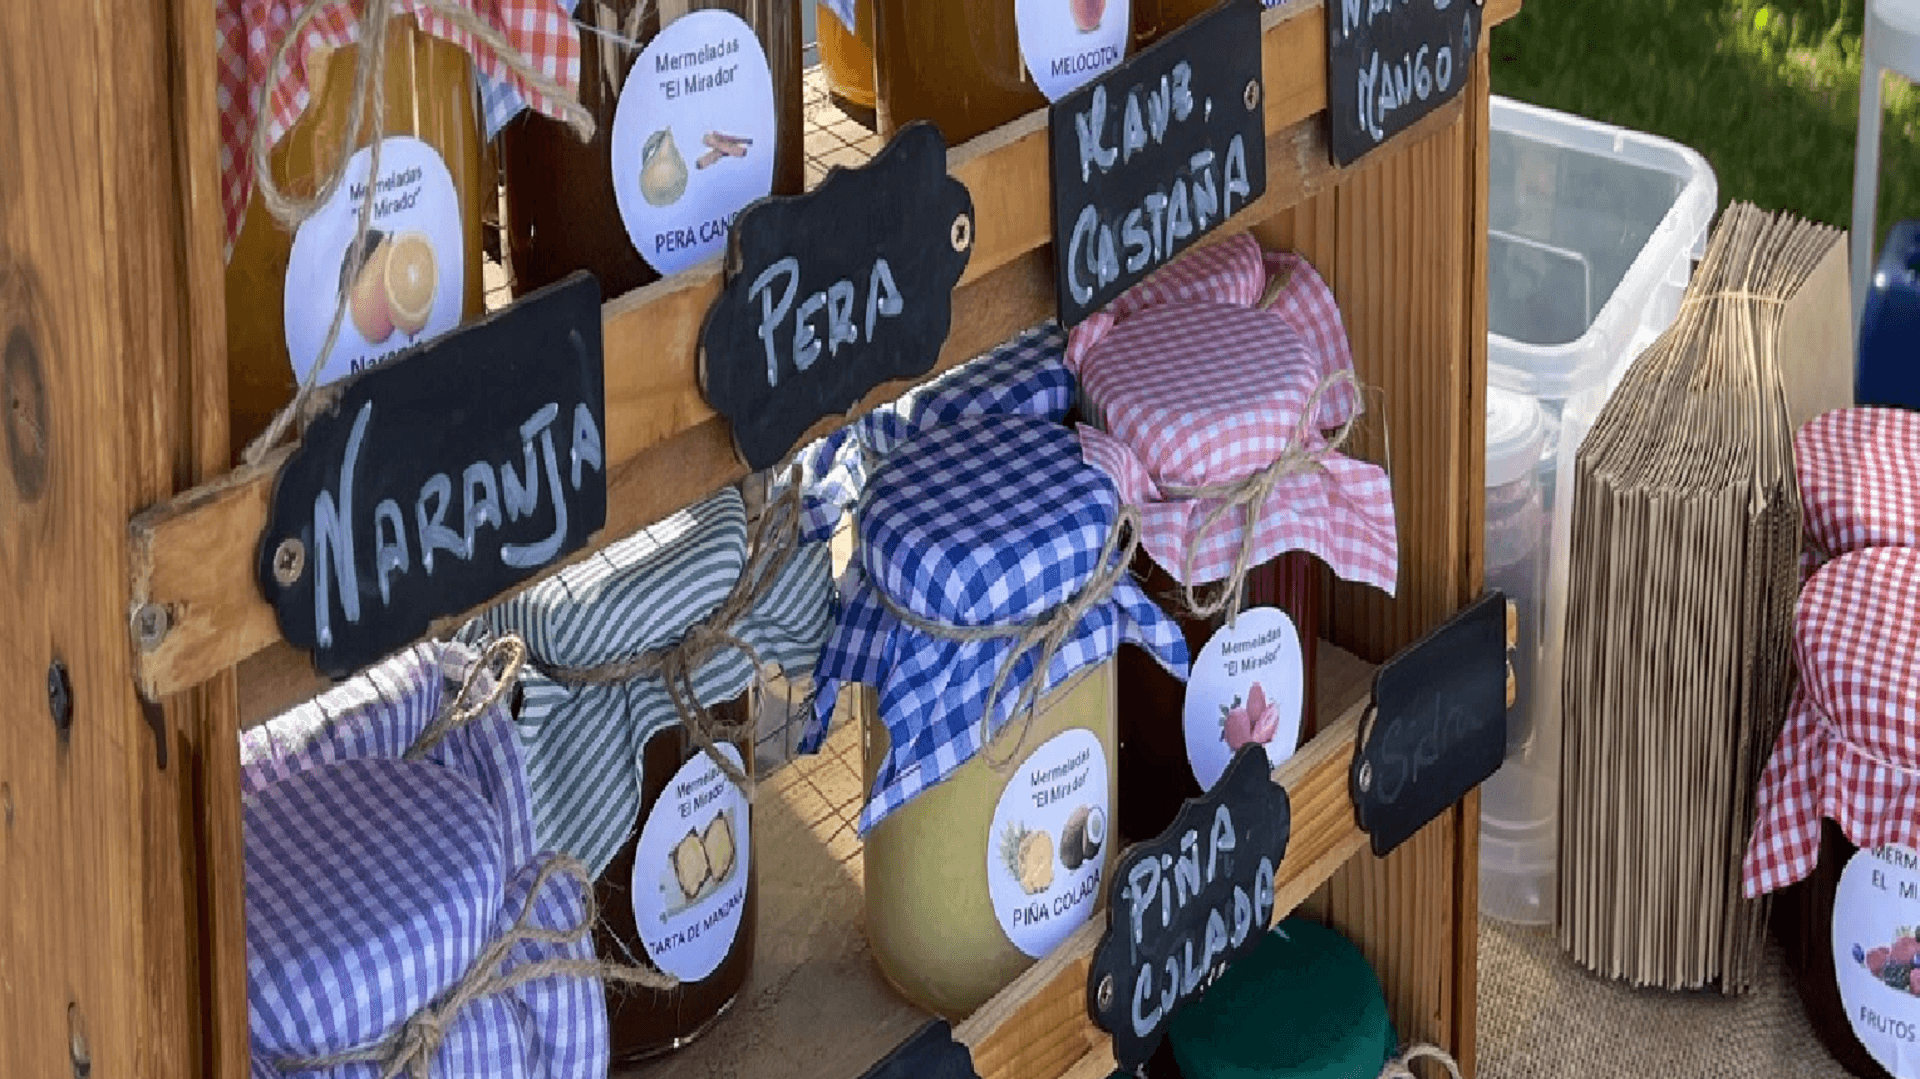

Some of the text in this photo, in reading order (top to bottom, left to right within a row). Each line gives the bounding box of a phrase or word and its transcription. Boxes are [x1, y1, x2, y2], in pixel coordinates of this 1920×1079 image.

[655, 38, 740, 74] Mermeladas
[1357, 43, 1452, 142] MANGO
[350, 165, 423, 201] Memeladas
[1067, 133, 1250, 306] CASTAÑA
[655, 226, 697, 254] PERA
[748, 255, 904, 388] PERA
[313, 399, 602, 649] NARANJA
[1030, 747, 1090, 788] Mermeladas
[1012, 867, 1101, 930] PIÑA COLADA
[1871, 868, 1888, 893] EL
[649, 930, 686, 957] TARTA
[687, 921, 700, 943] DE
[1860, 1005, 1916, 1043] FRUTOS
